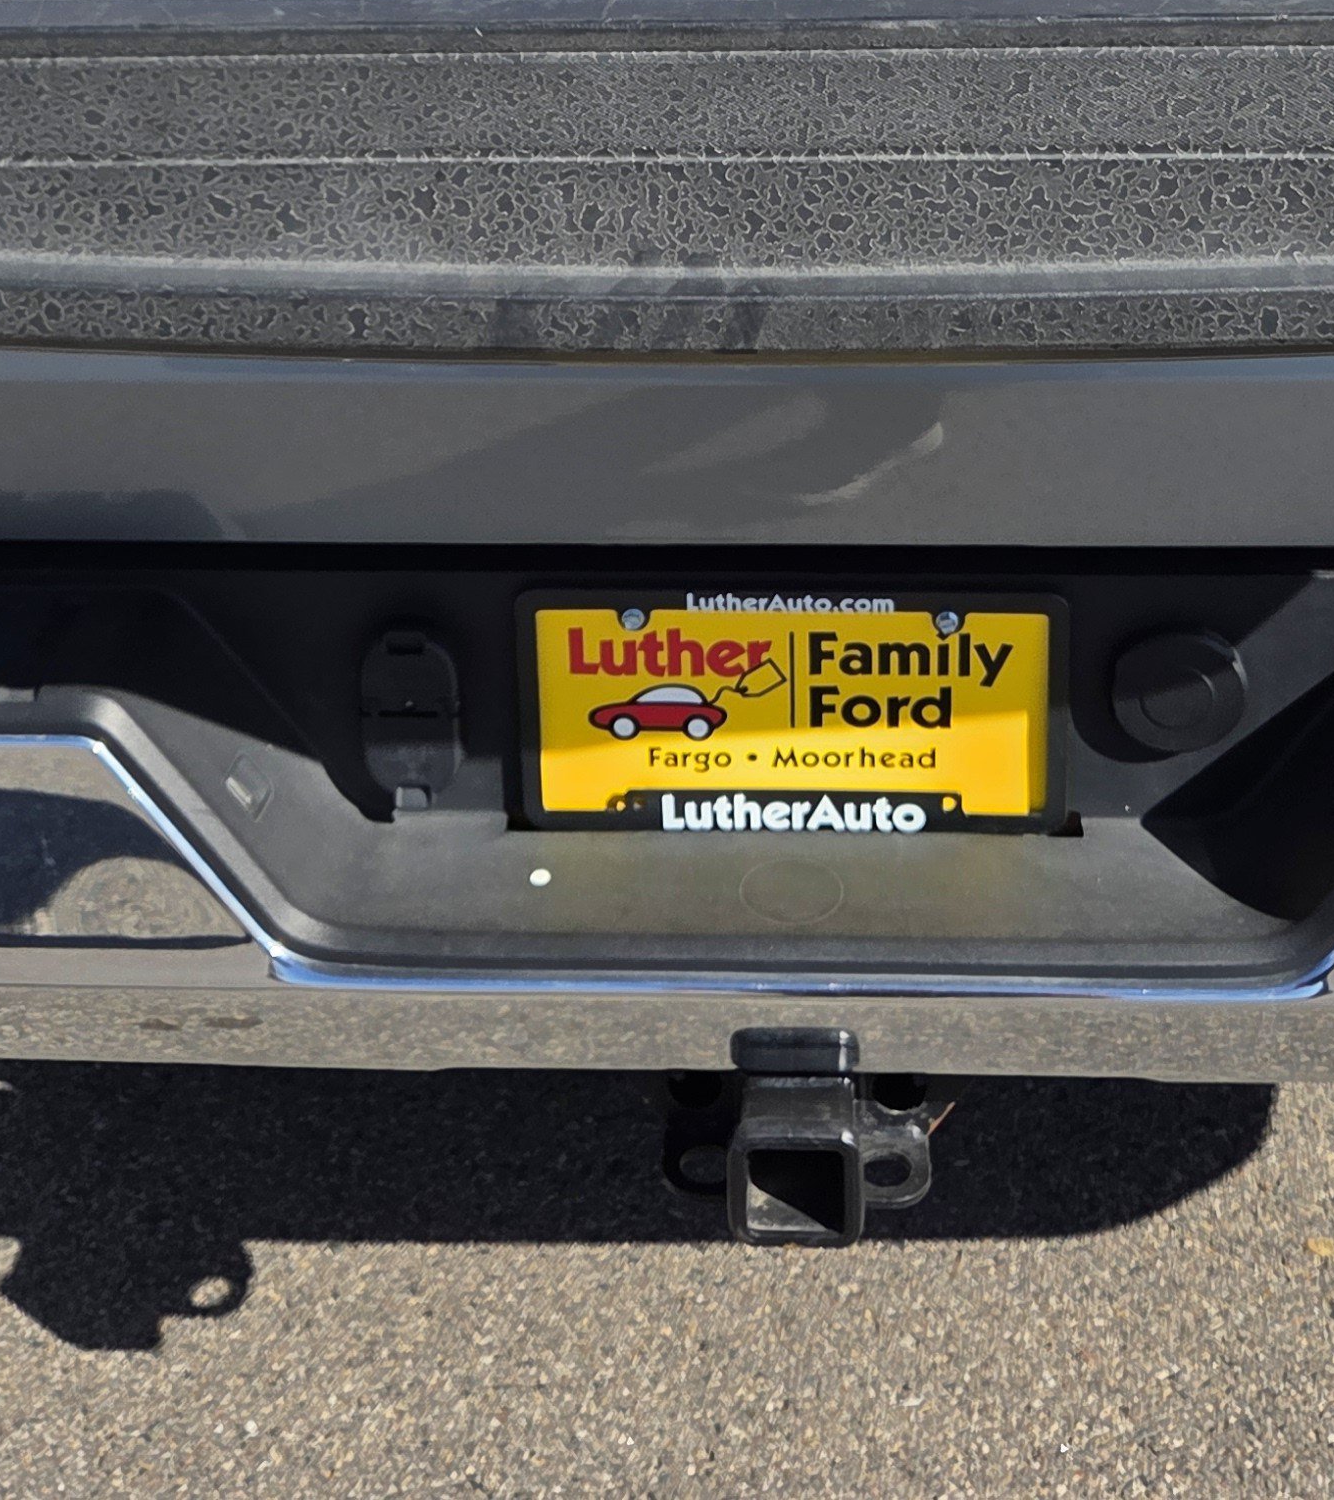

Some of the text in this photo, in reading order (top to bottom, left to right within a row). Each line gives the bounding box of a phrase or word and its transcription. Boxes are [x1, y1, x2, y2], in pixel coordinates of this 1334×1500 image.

[686, 593, 895, 614] LutherAuto.com
[568, 627, 1013, 687] Luther Family
[808, 686, 952, 729] Ford
[648, 746, 937, 773] Fargo Moorhead
[661, 793, 926, 833] LutherAuto
